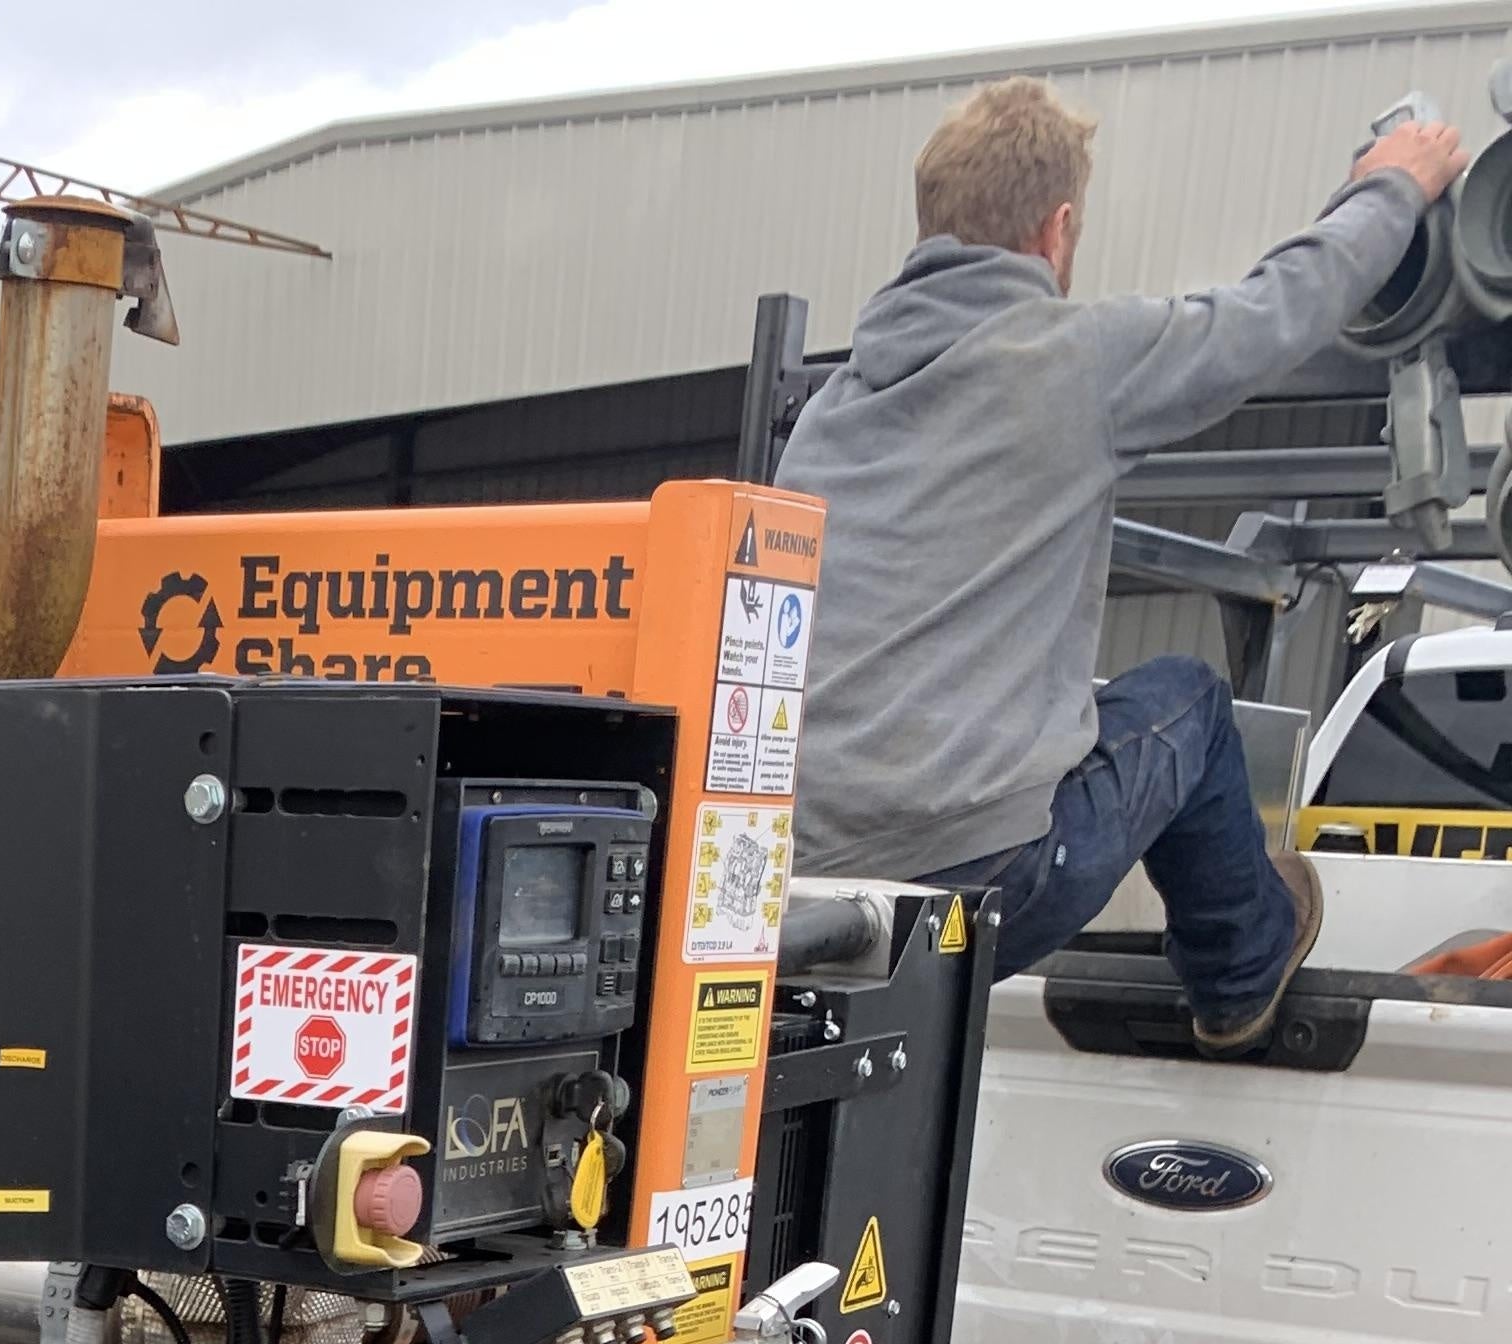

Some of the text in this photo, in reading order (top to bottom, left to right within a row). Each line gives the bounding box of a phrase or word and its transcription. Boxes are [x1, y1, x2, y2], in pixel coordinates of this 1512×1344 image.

[764, 528, 818, 558] WARNING
[238, 553, 635, 635] Equipment
[234, 636, 436, 682] Share
[260, 973, 389, 1014] EMERGENCY
[524, 991, 557, 1005] CP1000
[717, 988, 757, 1005] WARNING
[0, 1054, 42, 1065] DISCHARGE
[299, 1035, 341, 1059] STOP
[445, 1095, 529, 1160] LOFA
[443, 1156, 528, 1182] INDUSTRIES
[1139, 1152, 1232, 1198] Ford
[4, 1197, 35, 1205] SUCTION
[691, 1271, 727, 1291] ARNING
